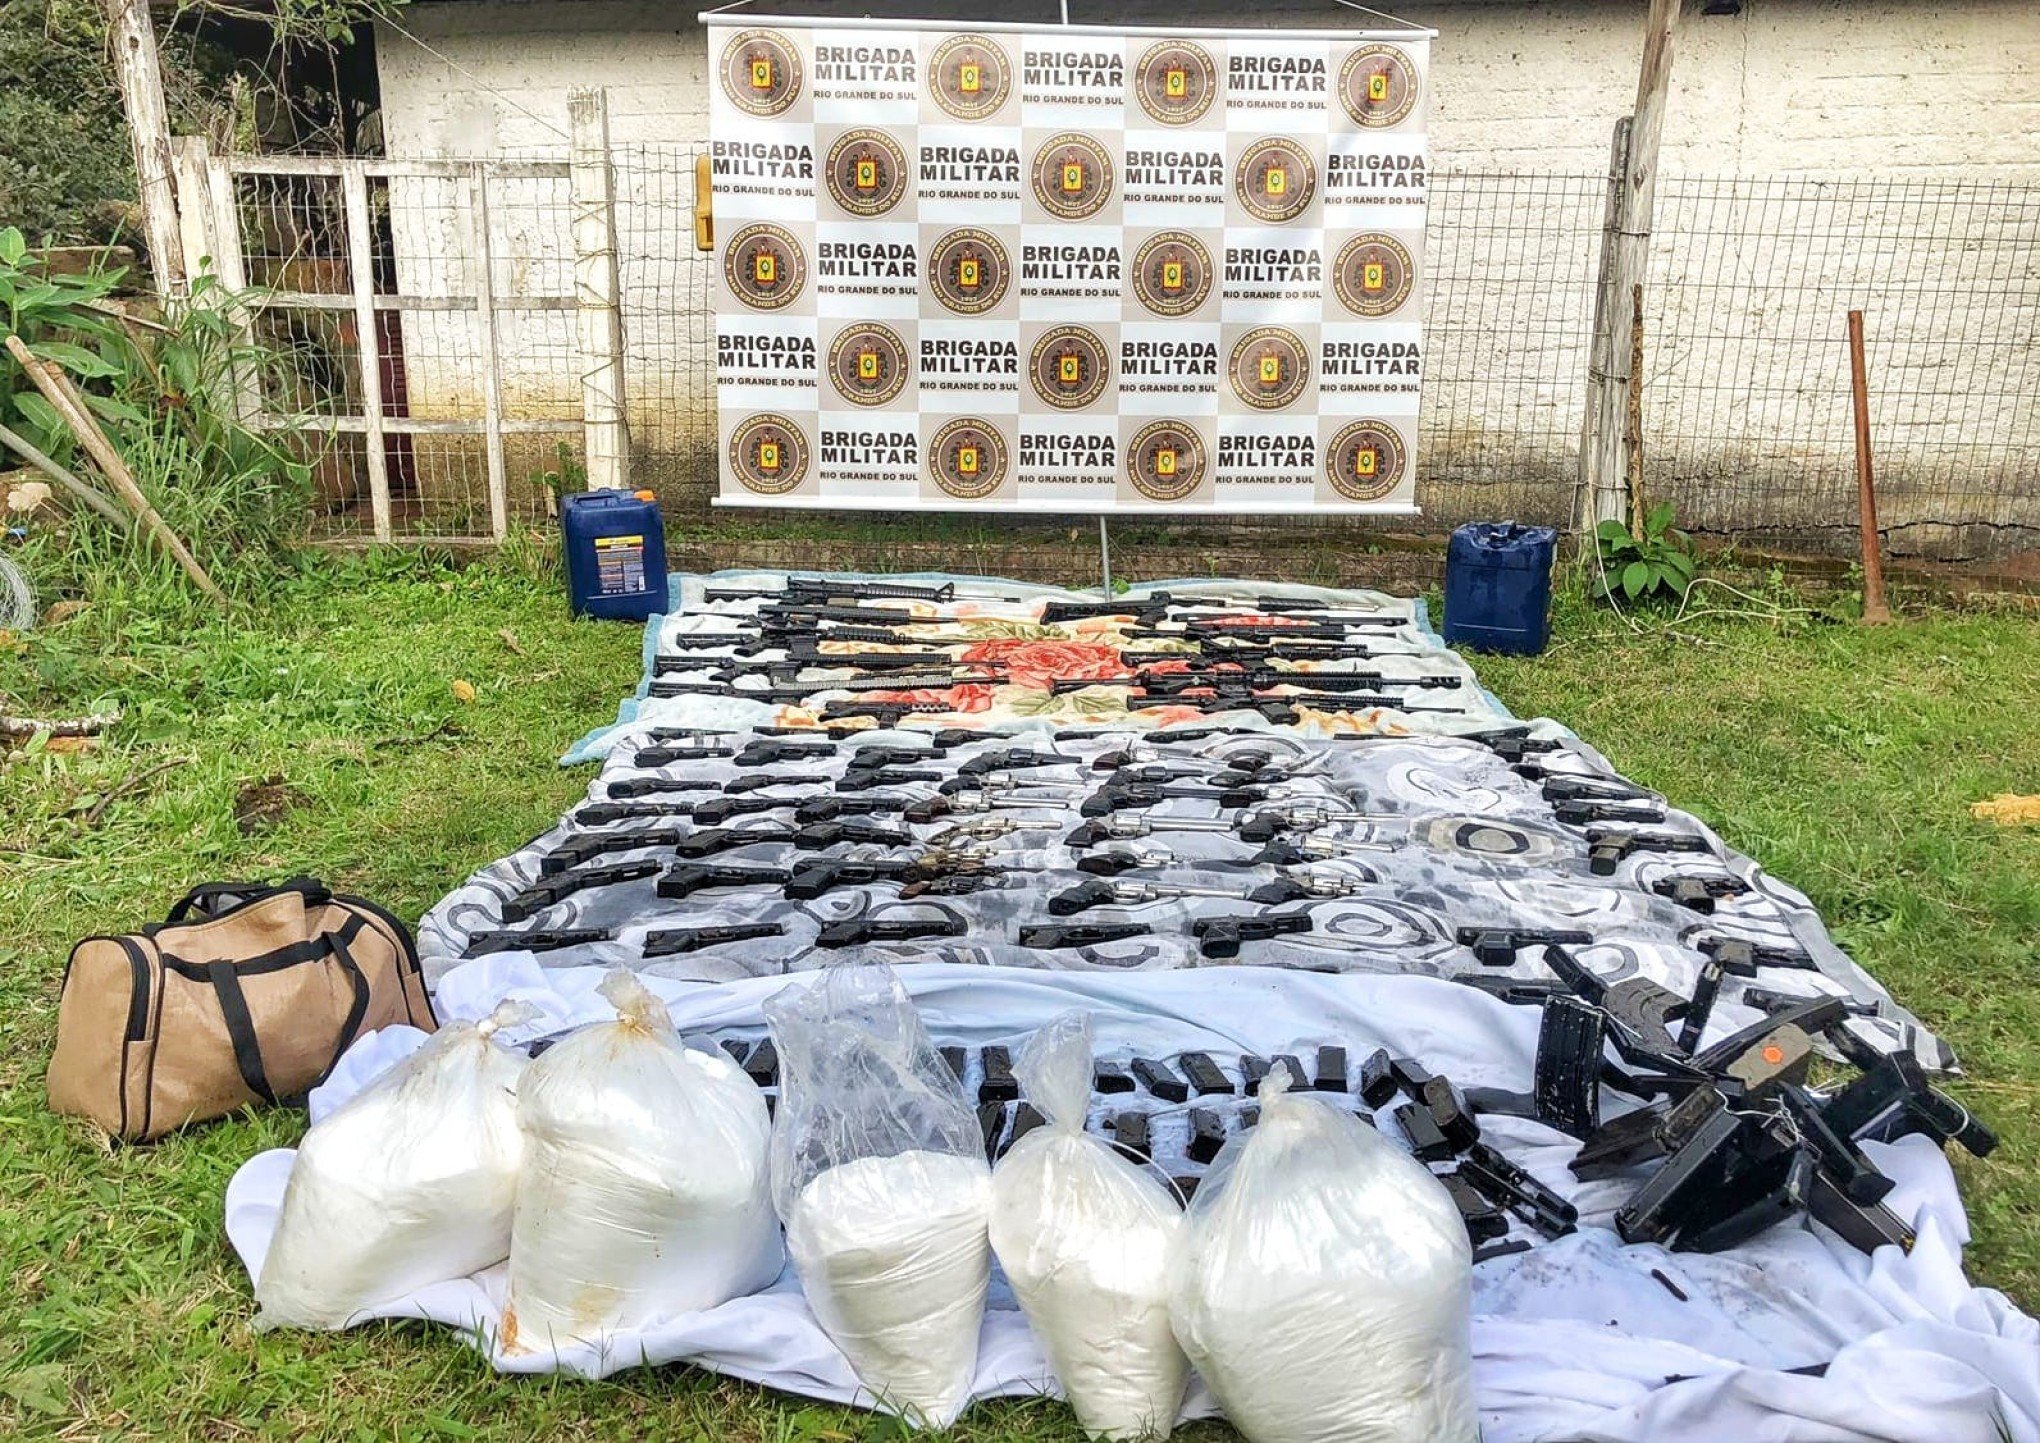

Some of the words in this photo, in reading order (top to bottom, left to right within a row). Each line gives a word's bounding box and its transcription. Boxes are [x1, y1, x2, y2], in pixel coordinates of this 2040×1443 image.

[816, 47, 916, 64] BRIGADA
[1024, 52, 1123, 69] BRIGADA
[816, 64, 915, 82] MILITAR
[1229, 56, 1326, 74] BRIGADA
[1024, 69, 1123, 87] MILITAR
[1228, 74, 1326, 91] MILITAR
[813, 90, 831, 98] RIO
[835, 91, 876, 99] GRANDE
[880, 92, 893, 100] DO
[898, 92, 916, 100] SUL
[1023, 95, 1040, 103] RIO
[1044, 95, 1084, 104] GRANDE
[1088, 96, 1102, 104] DO
[1105, 97, 1124, 105] SUL
[1226, 100, 1244, 108] RIO
[1247, 100, 1287, 109] GRANDE
[1291, 101, 1304, 109] DO
[1308, 102, 1326, 110] SUL
[713, 141, 813, 161] BRIGADA
[920, 147, 1020, 164] BRIGADA
[1126, 151, 1223, 168] BRIGADA
[1328, 155, 1425, 170] BRIGADA
[713, 158, 814, 179] MILITAR
[920, 164, 1020, 182] MILITAR
[1126, 168, 1223, 186] MILITAR
[1327, 172, 1424, 187] MILITAR
[711, 184, 730, 193] RIO
[733, 185, 774, 195] GRANDE
[778, 187, 792, 196] DO
[795, 188, 815, 197] SUL
[918, 190, 936, 198] RIO
[938, 190, 980, 199] GRANDE
[983, 191, 998, 199] DO
[1000, 191, 1020, 200] SUL
[1123, 194, 1141, 202] RIO
[1144, 194, 1185, 203] GRANDE
[1188, 195, 1202, 203] DO
[1204, 195, 1224, 204] SUL
[1324, 196, 1342, 204] RIO
[1346, 196, 1386, 204] GRANDE
[1406, 197, 1425, 205] SUL
[819, 242, 917, 260] BRIGADA
[1023, 246, 1120, 262] BRIGADA
[1226, 249, 1321, 265] BRIGADA
[819, 260, 917, 278] MILITAR
[1022, 264, 1120, 280] MILITAR
[1225, 266, 1321, 282] MILITAR
[818, 285, 835, 294] RIO
[838, 285, 879, 295] GRANDE
[882, 286, 897, 295] DO
[900, 286, 919, 295] SUL
[1020, 288, 1038, 296] RIO
[1041, 288, 1082, 297] GRANDE
[1084, 288, 1099, 297] DO
[1101, 289, 1122, 297] SUL
[1223, 291, 1240, 299] RIO
[1242, 291, 1282, 299] GRANDE
[1286, 291, 1299, 299] DO
[1302, 291, 1322, 299] SUL
[718, 335, 816, 352] BRIGADA
[921, 340, 1018, 357] BRIGADA
[1122, 342, 1218, 358] BRIGADA
[1323, 343, 1420, 358] BRIGADA
[718, 352, 816, 370] MILITAR
[921, 357, 1018, 374] MILITAR
[1122, 359, 1217, 375] MILITAR
[1322, 360, 1419, 374] MILITAR
[716, 376, 734, 385] RIO
[737, 377, 778, 386] GRANDE
[781, 378, 795, 387] DO
[798, 379, 817, 387] SUL
[919, 381, 936, 390] RIO
[940, 381, 980, 390] GRANDE
[982, 382, 997, 391] DO
[999, 383, 1018, 391] SUL
[1119, 384, 1136, 392] RIO
[1139, 384, 1180, 393] GRANDE
[1182, 384, 1196, 393] DO
[1198, 384, 1217, 393] SUL
[1320, 384, 1337, 392] RIO
[1340, 384, 1381, 392] GRANDE
[1384, 384, 1398, 392] DO
[1400, 384, 1420, 392] SUL
[821, 431, 917, 448] BRIGADA
[1020, 434, 1116, 450] BRIGADA
[1219, 436, 1315, 450] BRIGADA
[821, 448, 917, 464] MILITAR
[1020, 451, 1115, 467] MILITAR
[1218, 452, 1314, 467] MILITAR
[820, 471, 837, 479] RIO
[840, 472, 880, 480] GRANDE
[882, 473, 896, 481] DO
[899, 473, 918, 481] SUL
[1018, 475, 1035, 483] RIO
[1038, 475, 1078, 483] GRANDE
[1080, 476, 1094, 484] DO
[1097, 476, 1116, 484] SUL
[1215, 476, 1232, 484] RIO
[1236, 476, 1276, 484] GRANDE
[1278, 476, 1292, 484] DO
[1296, 476, 1314, 484] SUL
